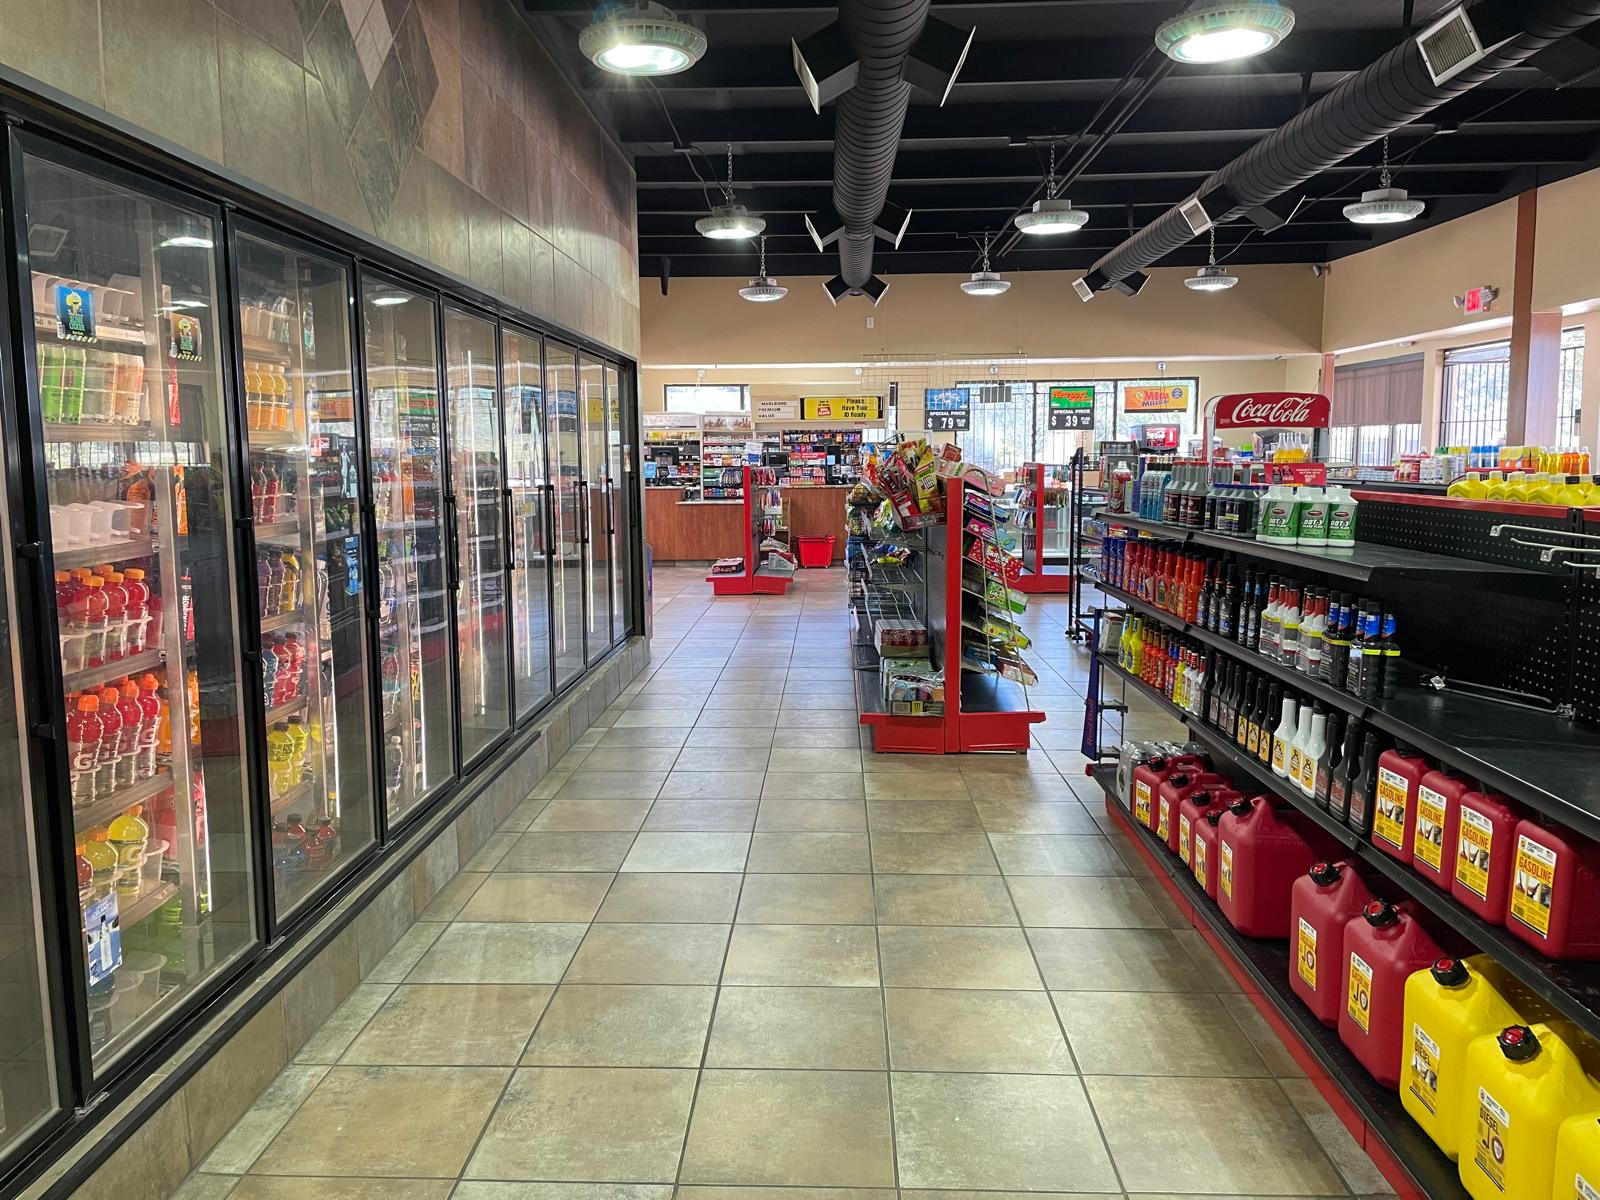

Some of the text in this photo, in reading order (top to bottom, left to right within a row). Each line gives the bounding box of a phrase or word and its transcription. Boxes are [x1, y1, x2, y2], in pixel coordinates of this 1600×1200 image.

[1231, 396, 1316, 424] Coca-Cola
[1379, 785, 1404, 806] GASOLINE
[1420, 804, 1442, 826] GASOLINE
[1461, 825, 1489, 850] GASOLINE
[1518, 856, 1553, 884] GASOLINE
[1415, 1041, 1432, 1067] DIESEL
[1480, 1107, 1500, 1136] DIESEL
